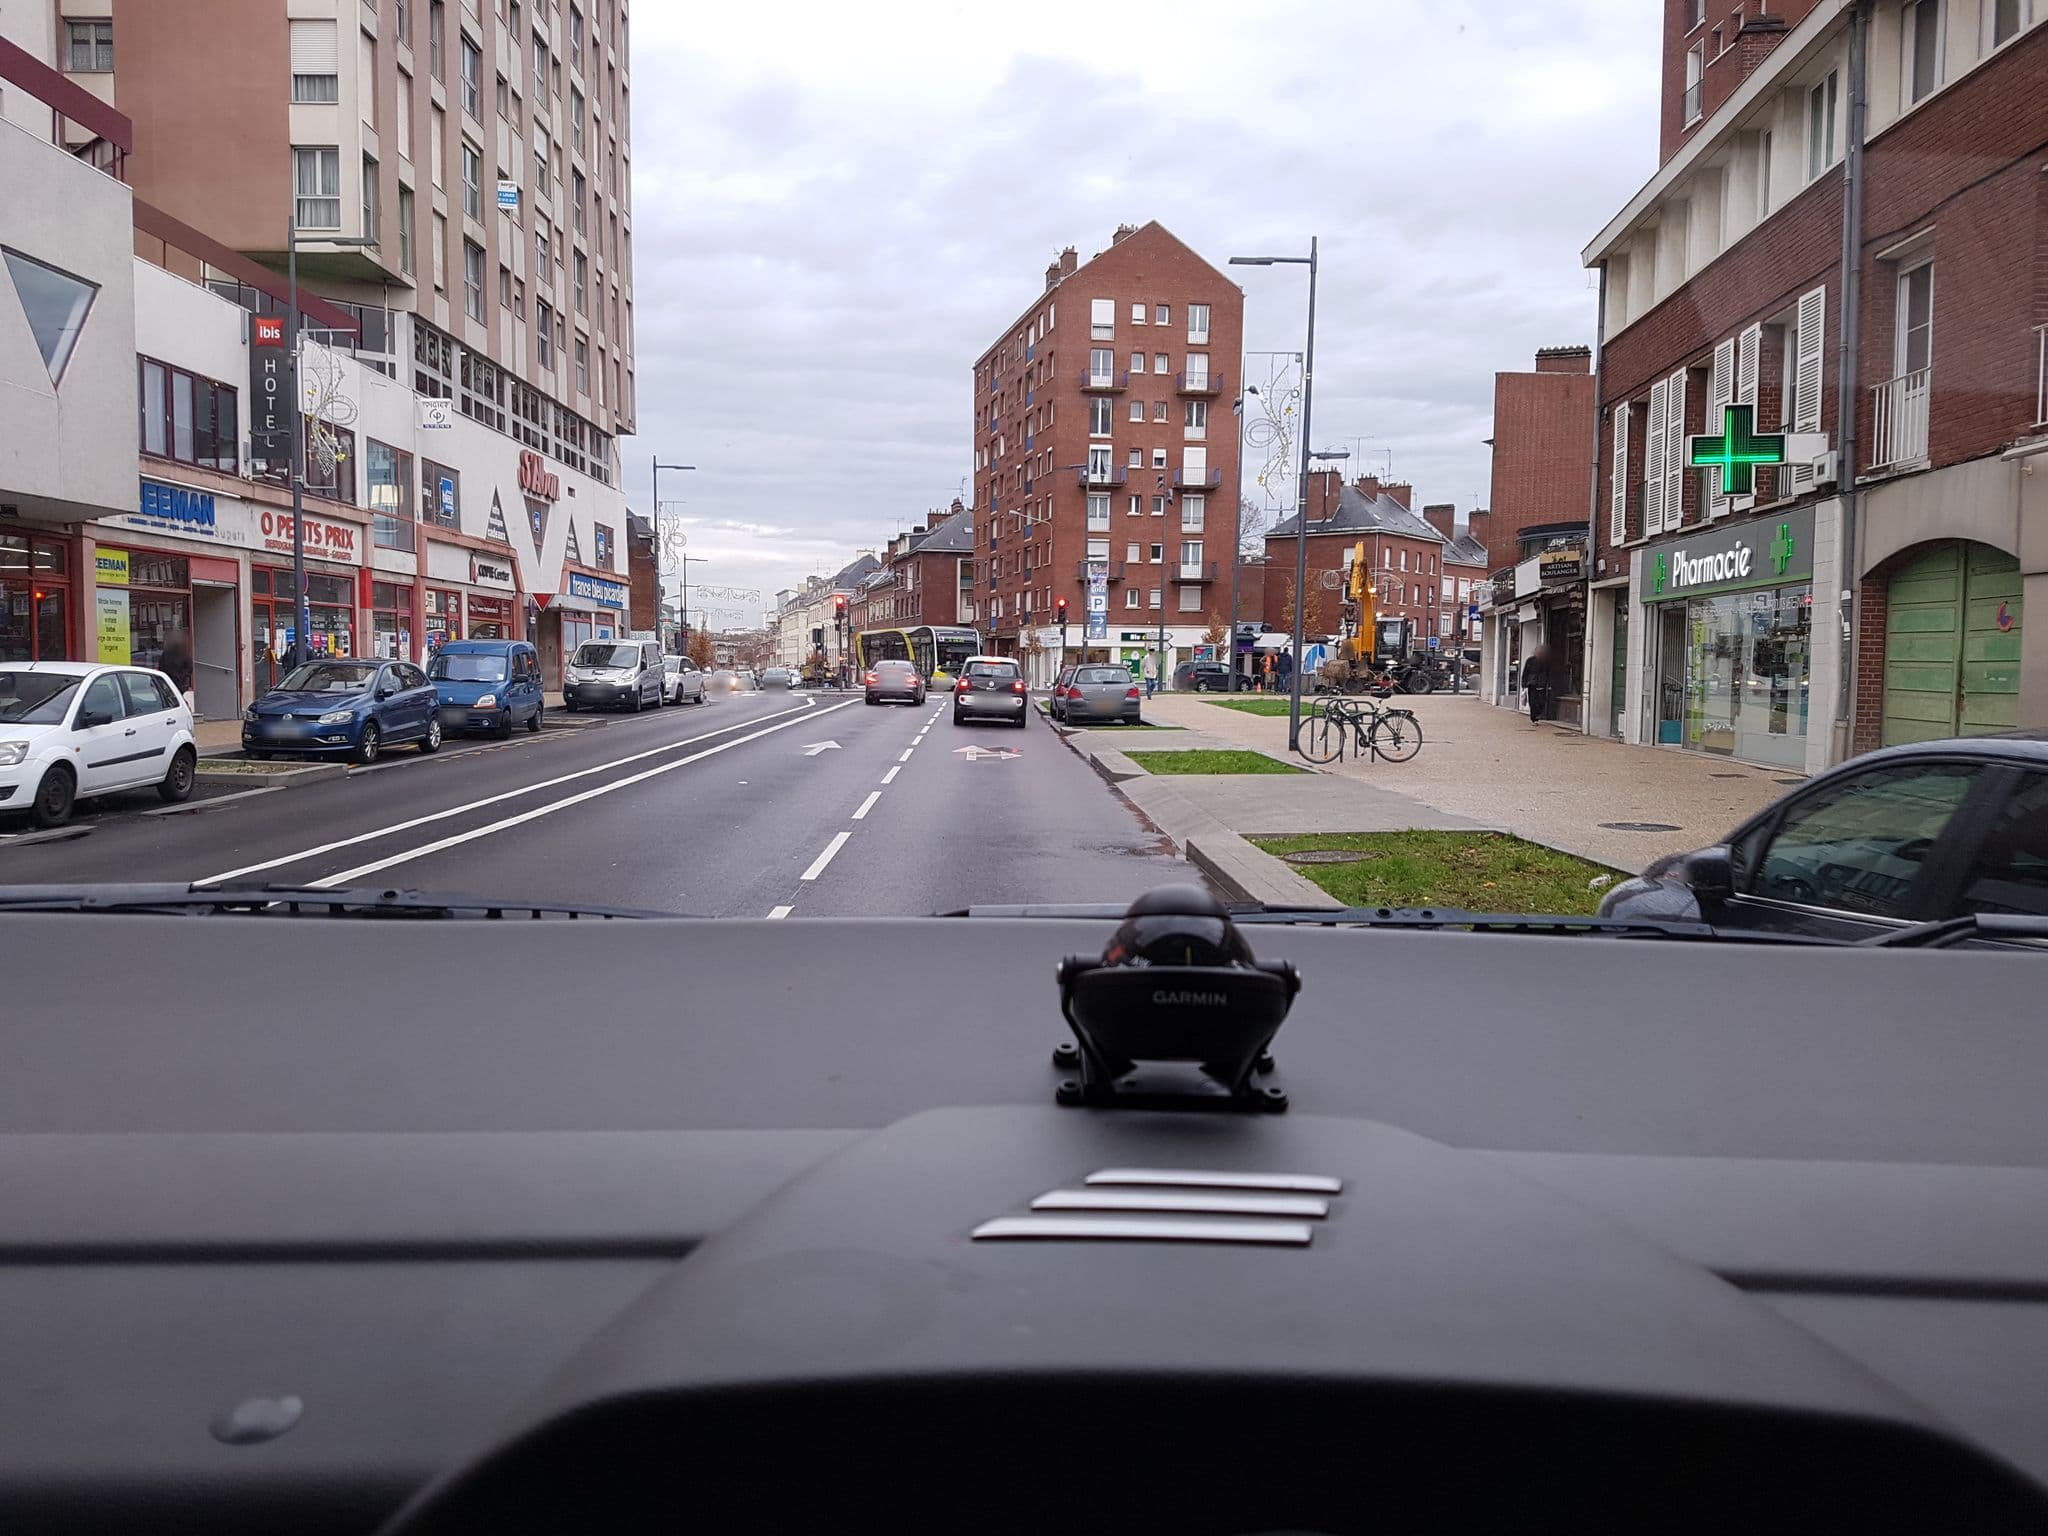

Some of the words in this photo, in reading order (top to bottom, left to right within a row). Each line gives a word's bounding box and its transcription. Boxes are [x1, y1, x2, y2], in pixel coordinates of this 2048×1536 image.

[259, 326, 280, 338] ibis
[265, 359, 277, 447] HOTEL
[140, 482, 215, 526] EEMAN
[325, 525, 354, 550] PRIX
[1541, 568, 1578, 577] BOULANGER
[1547, 562, 1573, 570] ARTISAN
[1672, 540, 1752, 588] Pharmacie
[573, 575, 592, 597] france
[591, 579, 604, 600] bleu
[1094, 598, 1103, 610] P
[1152, 990, 1228, 1006] GARMIN
